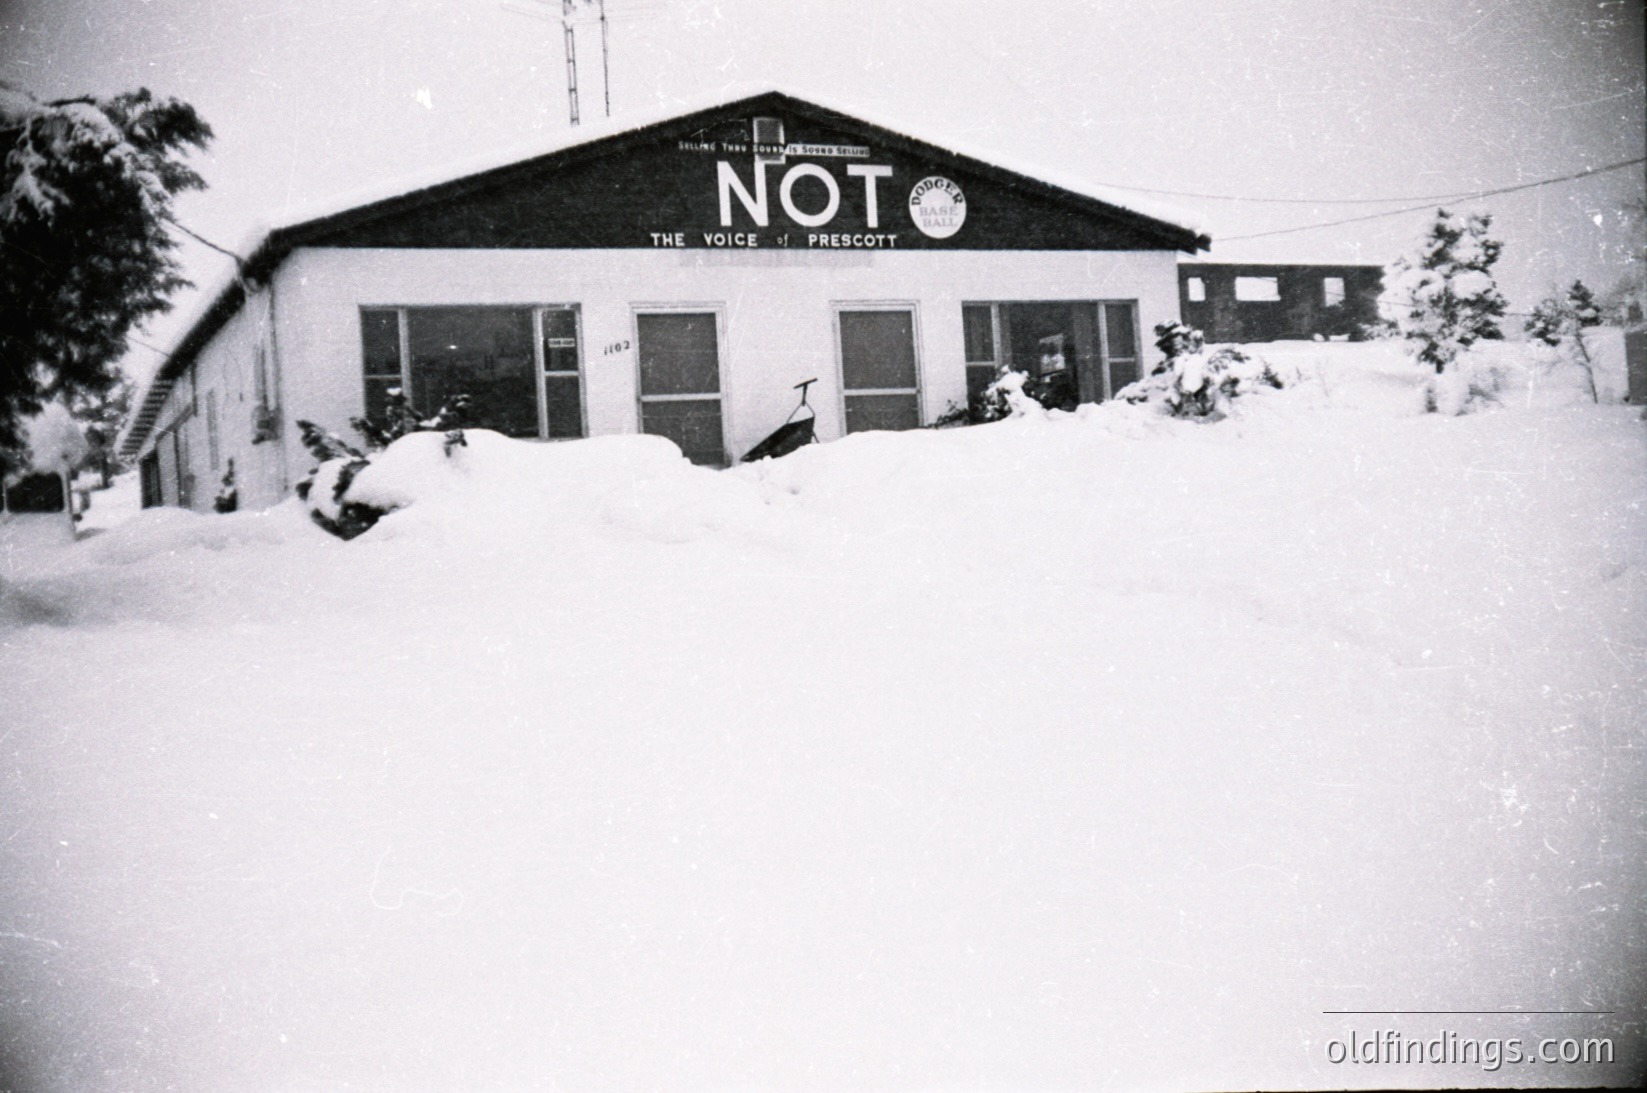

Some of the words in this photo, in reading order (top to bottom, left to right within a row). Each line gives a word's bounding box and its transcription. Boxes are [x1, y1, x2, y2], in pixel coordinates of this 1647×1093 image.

[716, 161, 893, 228] NOT
[911, 178, 964, 206] DODGER
[919, 205, 959, 217] BASE
[922, 217, 959, 228] BALL
[650, 232, 686, 247] THE
[703, 232, 758, 247] VOICE
[777, 233, 788, 247] of
[808, 233, 897, 248] PRESCOTT
[603, 340, 630, 355] 1102
